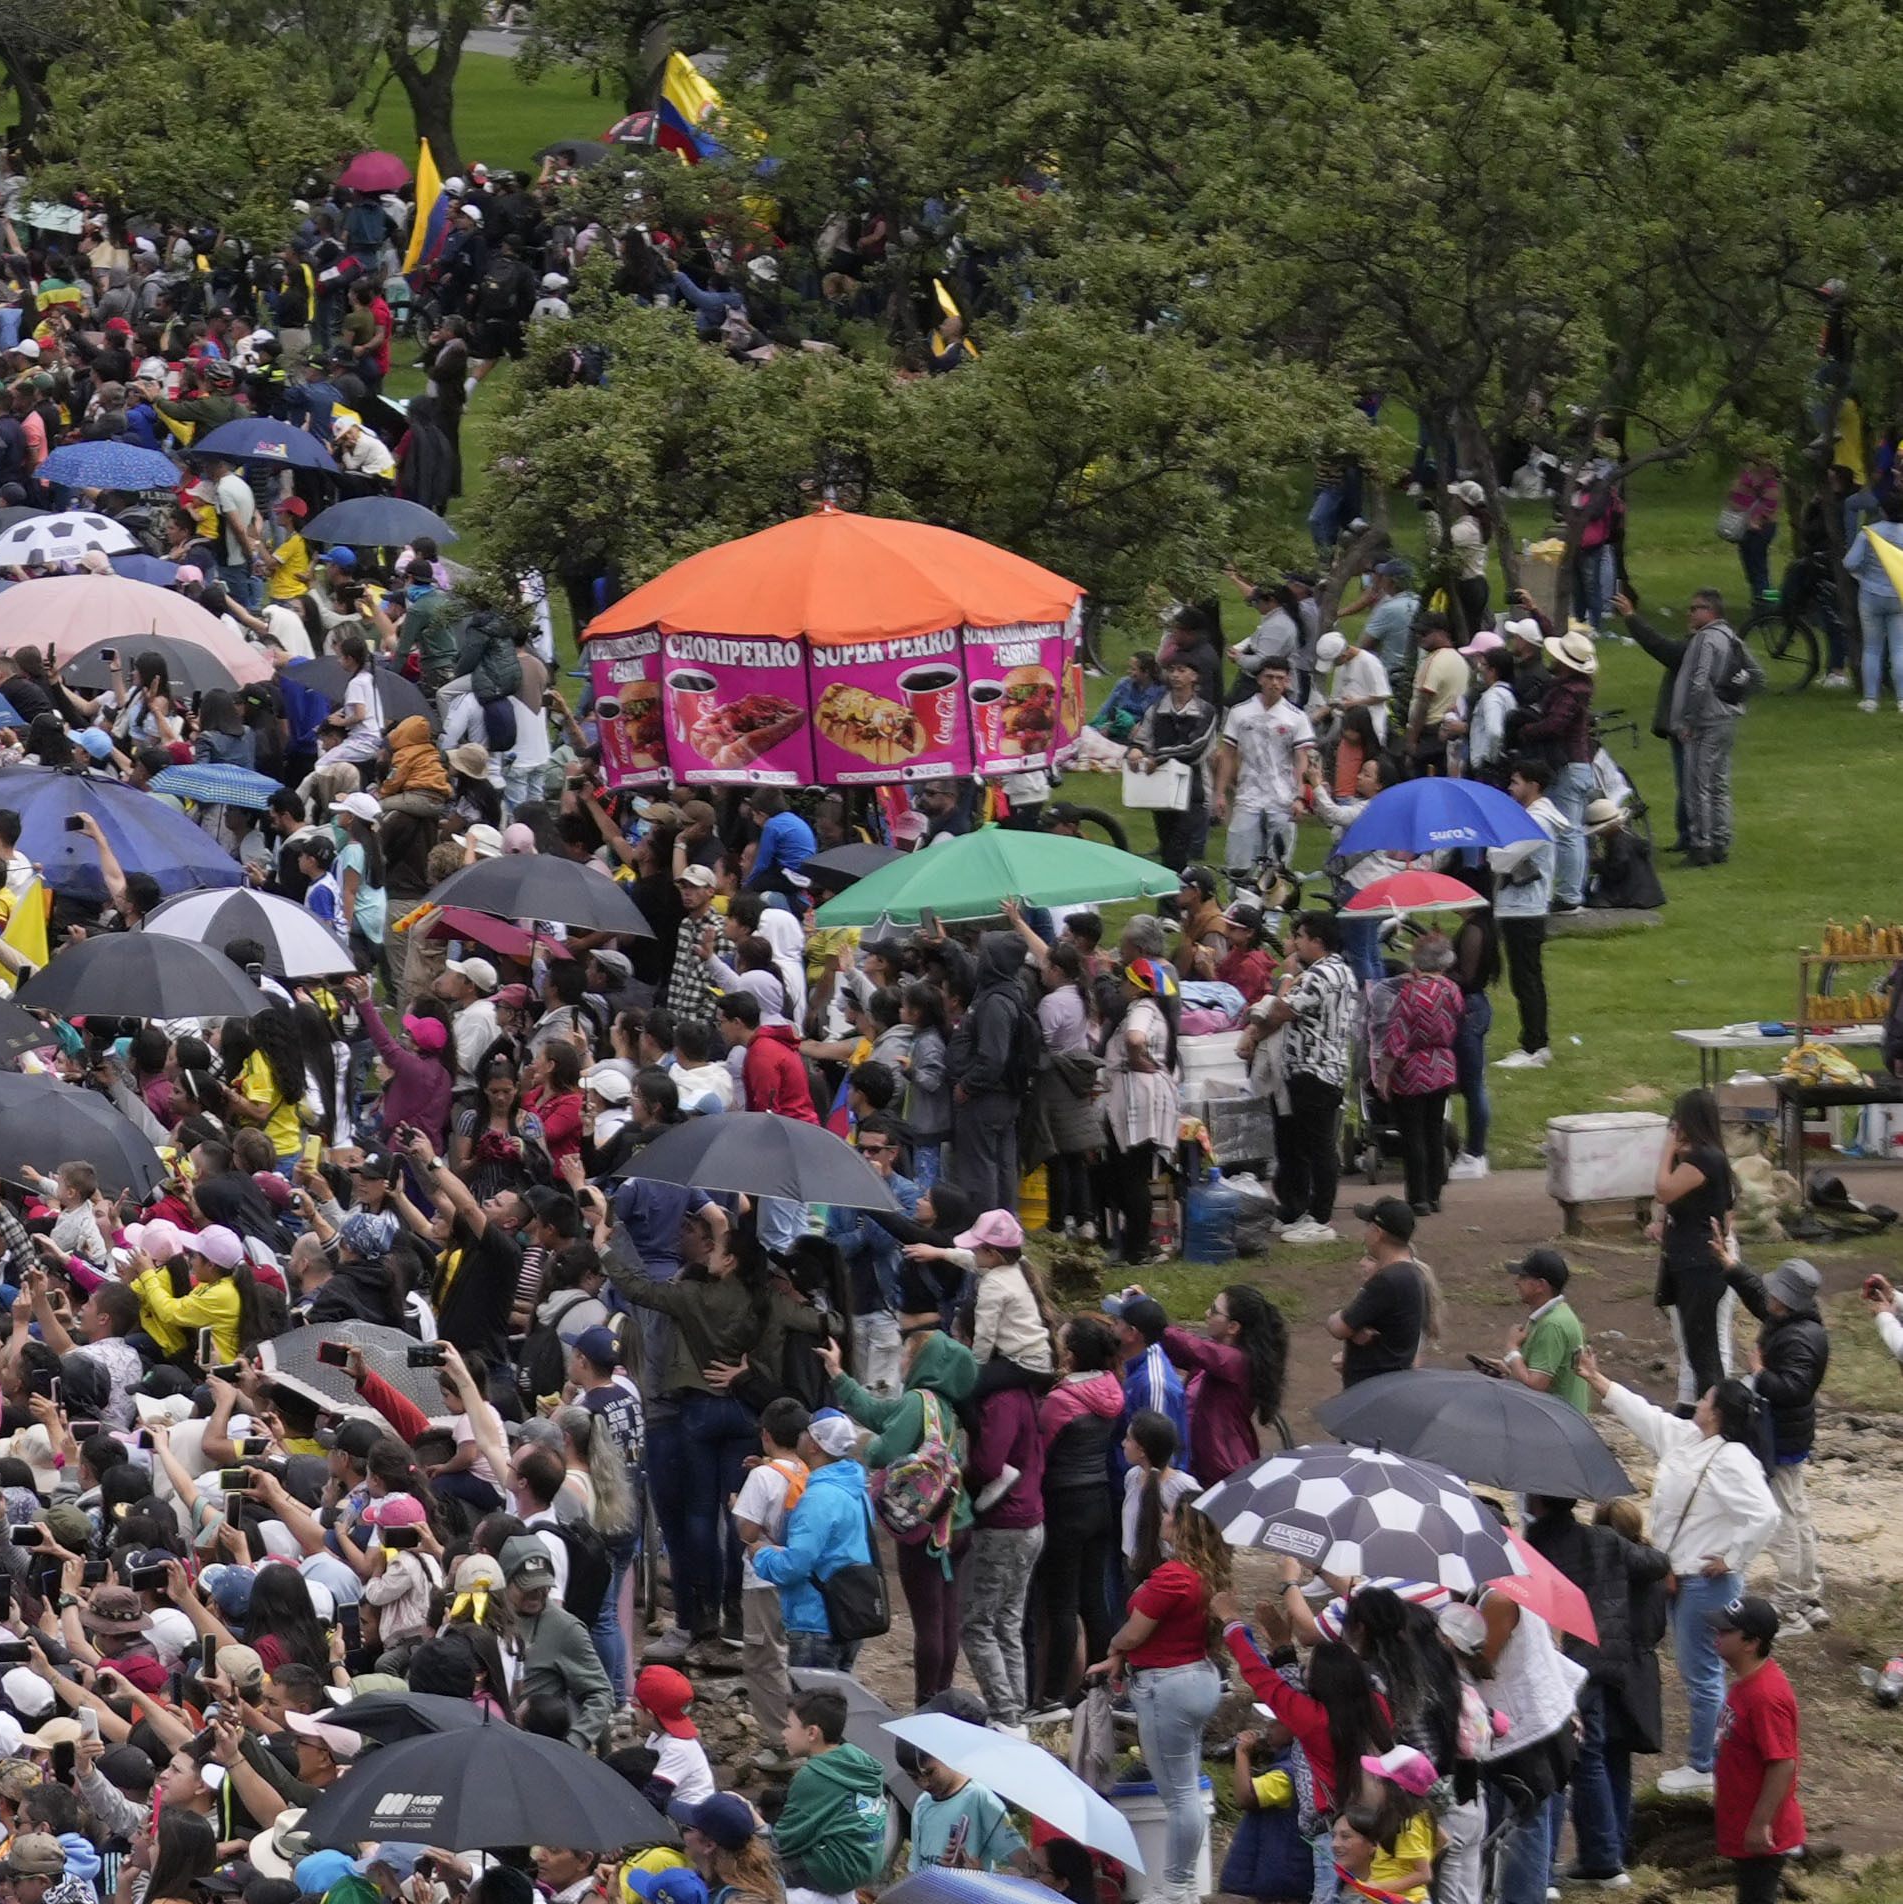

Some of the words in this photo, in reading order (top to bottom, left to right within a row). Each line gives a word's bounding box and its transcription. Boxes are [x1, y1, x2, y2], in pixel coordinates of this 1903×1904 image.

[665, 633, 802, 668] CHORIPERRO
[812, 640, 884, 668] SUPER
[888, 628, 956, 660] PERRO
[1429, 830, 1465, 842] sura
[1272, 1525, 1323, 1545] ALKOSTO
[411, 1795, 443, 1805] MER
[406, 1804, 436, 1815] Group
[369, 1820, 400, 1828] Telecom
[402, 1820, 431, 1828] Division
